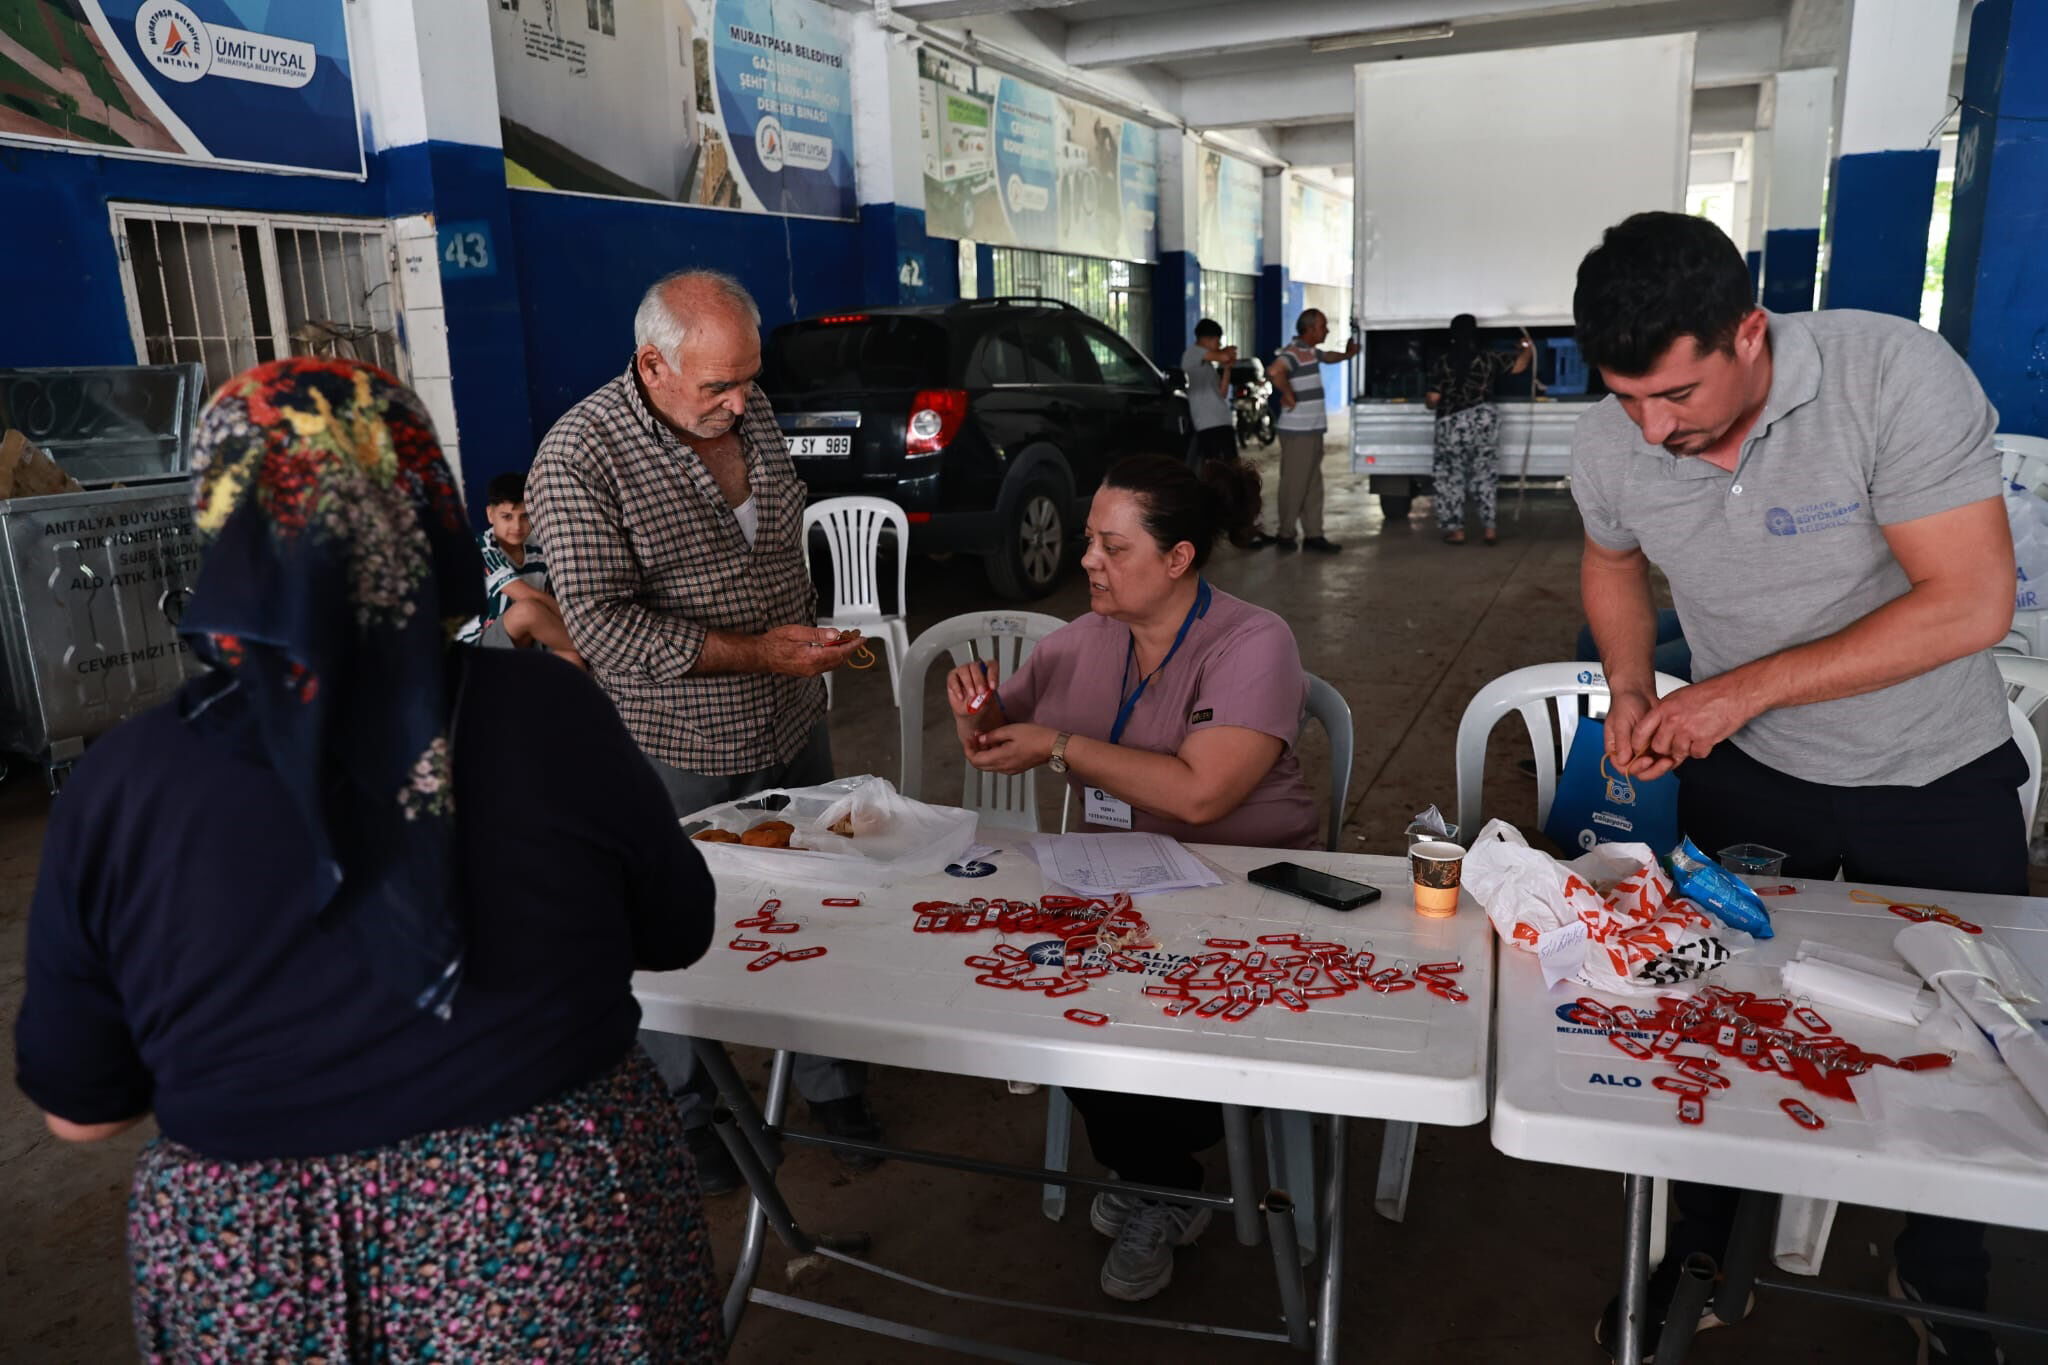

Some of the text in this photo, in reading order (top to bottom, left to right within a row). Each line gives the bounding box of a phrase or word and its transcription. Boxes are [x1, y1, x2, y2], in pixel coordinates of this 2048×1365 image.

[731, 26, 793, 56] MURATPAŞA
[156, 55, 200, 70] ANTALYA
[216, 36, 306, 70] ÜMİT UYSAL
[445, 232, 488, 268] 43
[801, 438, 816, 453] SY
[826, 438, 848, 453] 989
[45, 517, 115, 536] ANTALYA
[1589, 1073, 1642, 1088] ALO
